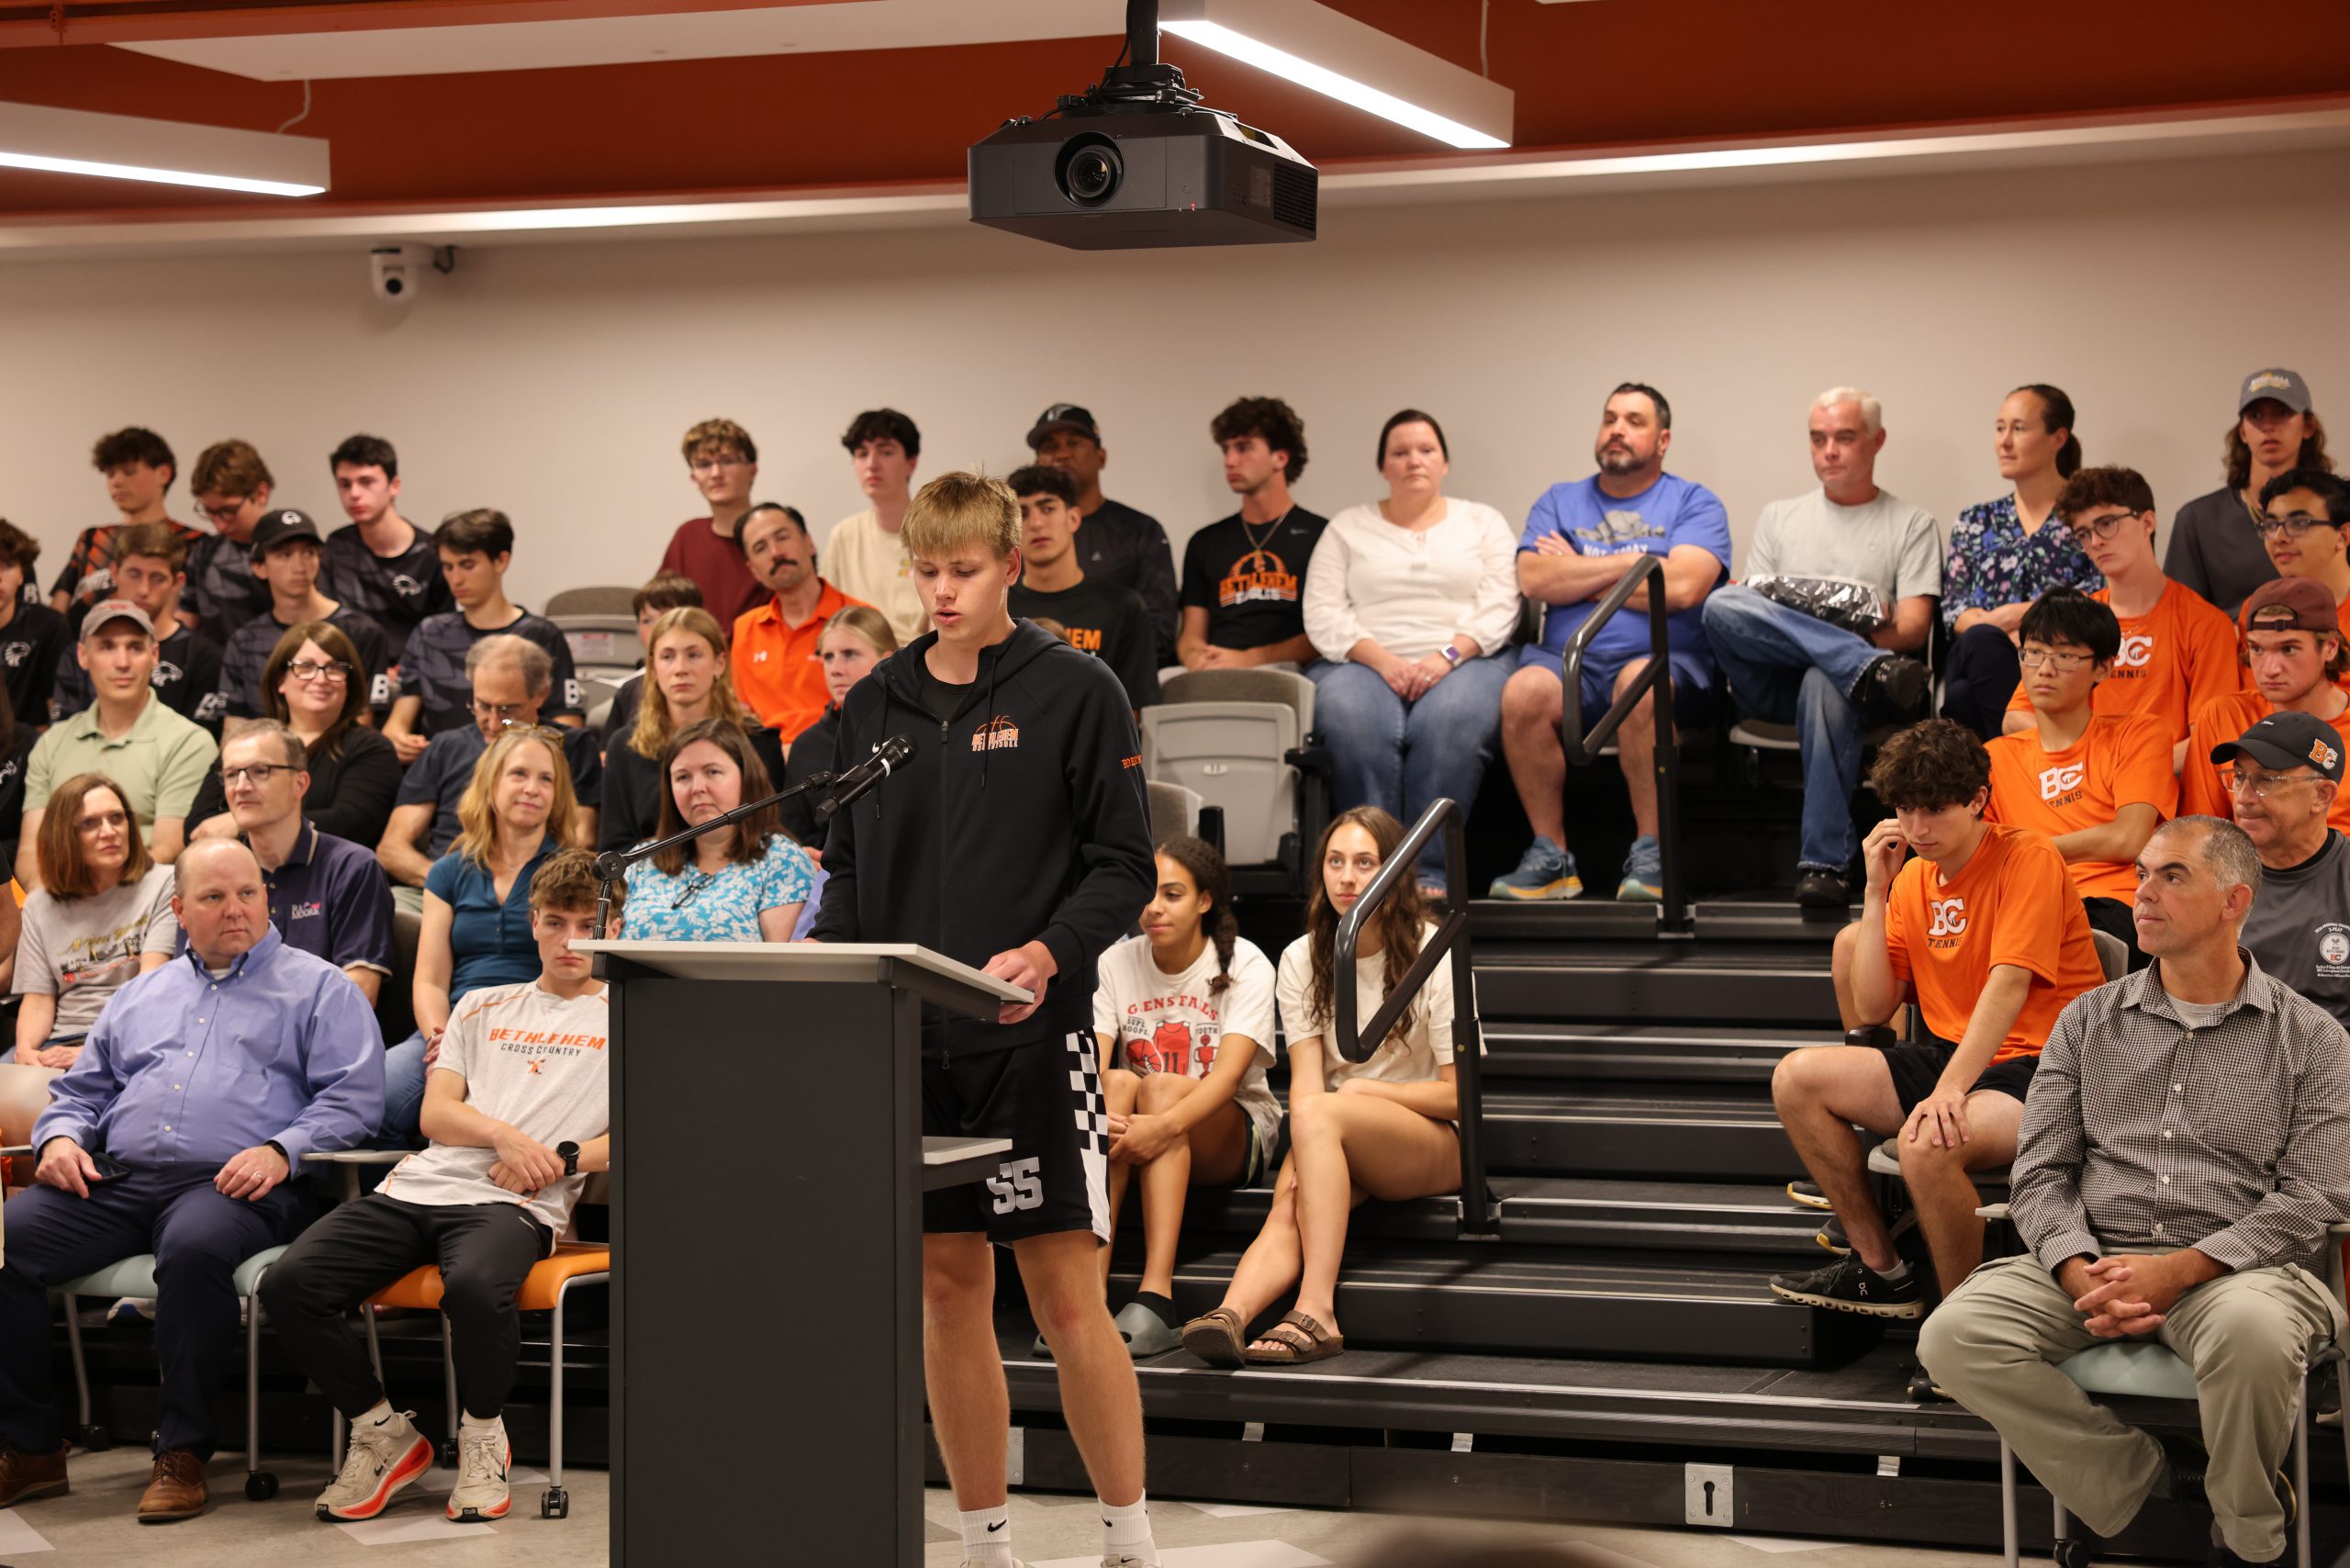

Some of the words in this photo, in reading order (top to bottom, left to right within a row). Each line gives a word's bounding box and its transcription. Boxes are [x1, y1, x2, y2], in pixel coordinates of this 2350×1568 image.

[2110, 669, 2146, 678] ENNIS
[2038, 760, 2084, 801] BC
[2049, 790, 2083, 809] ENNIS
[1927, 897, 1967, 936] BC
[1127, 995, 1175, 1015] GENS
[1180, 995, 1218, 1021] FALS
[1126, 1018, 1146, 1028] SUP
[489, 1028, 606, 1050] BETHLEHEM
[500, 1043, 532, 1055] CROSS
[986, 1157, 1044, 1215] 55
